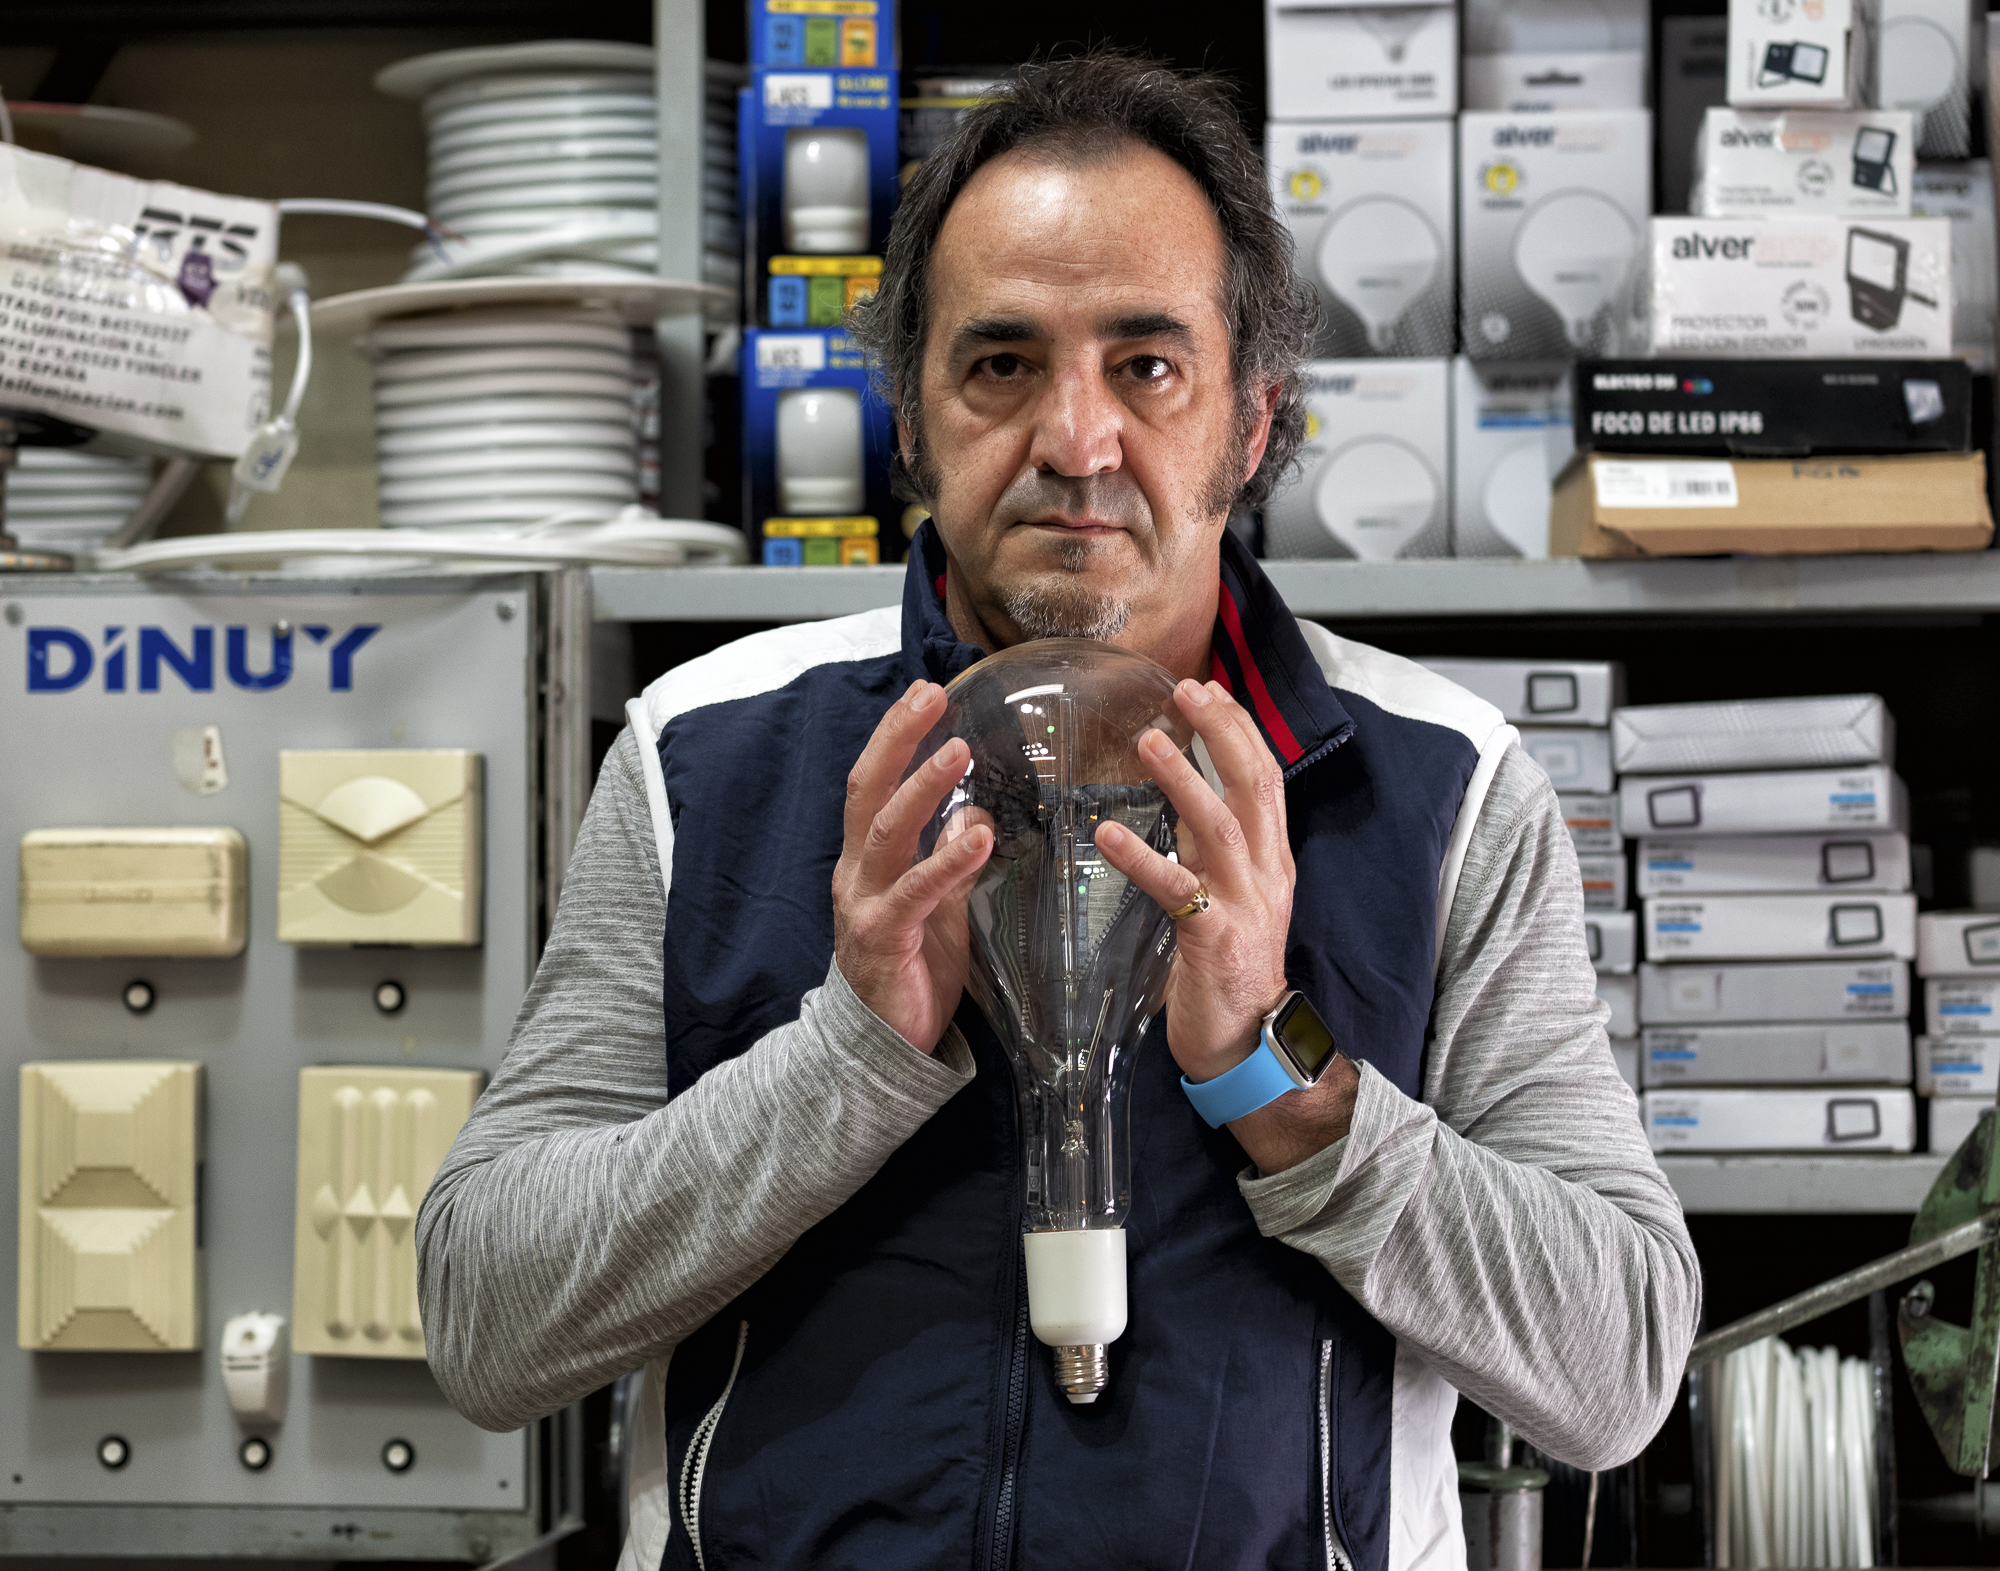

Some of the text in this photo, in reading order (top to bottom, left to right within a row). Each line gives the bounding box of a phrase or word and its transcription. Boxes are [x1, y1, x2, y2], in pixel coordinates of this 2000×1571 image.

[1672, 233, 1754, 259] alver
[1592, 411, 1645, 434] FOCO
[1648, 411, 1676, 434] DE
[1679, 411, 1715, 434] LED
[1719, 411, 1764, 434] IP66
